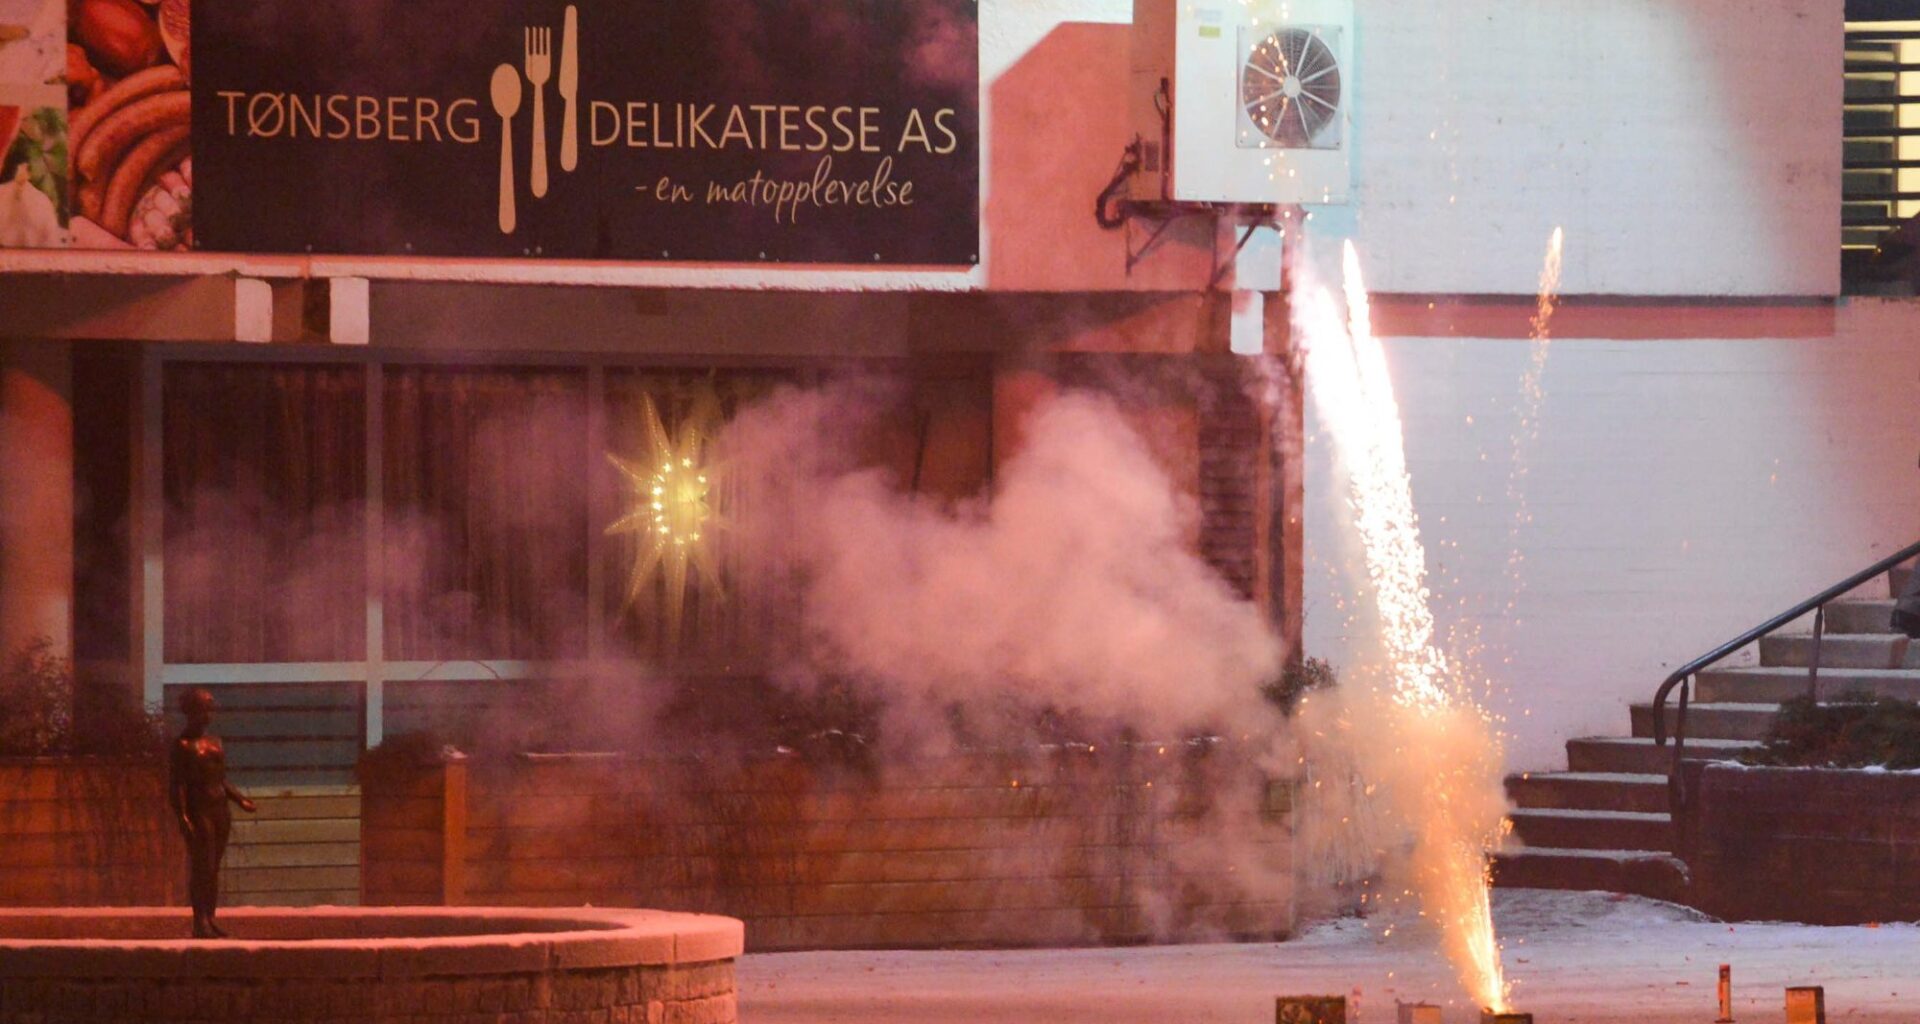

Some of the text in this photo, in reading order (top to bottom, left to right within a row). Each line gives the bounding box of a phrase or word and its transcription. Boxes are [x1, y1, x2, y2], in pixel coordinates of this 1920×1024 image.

[217, 91, 957, 154] TØNSBERG DELIKATESSE AS
[706, 156, 914, 224] matopplevelse
